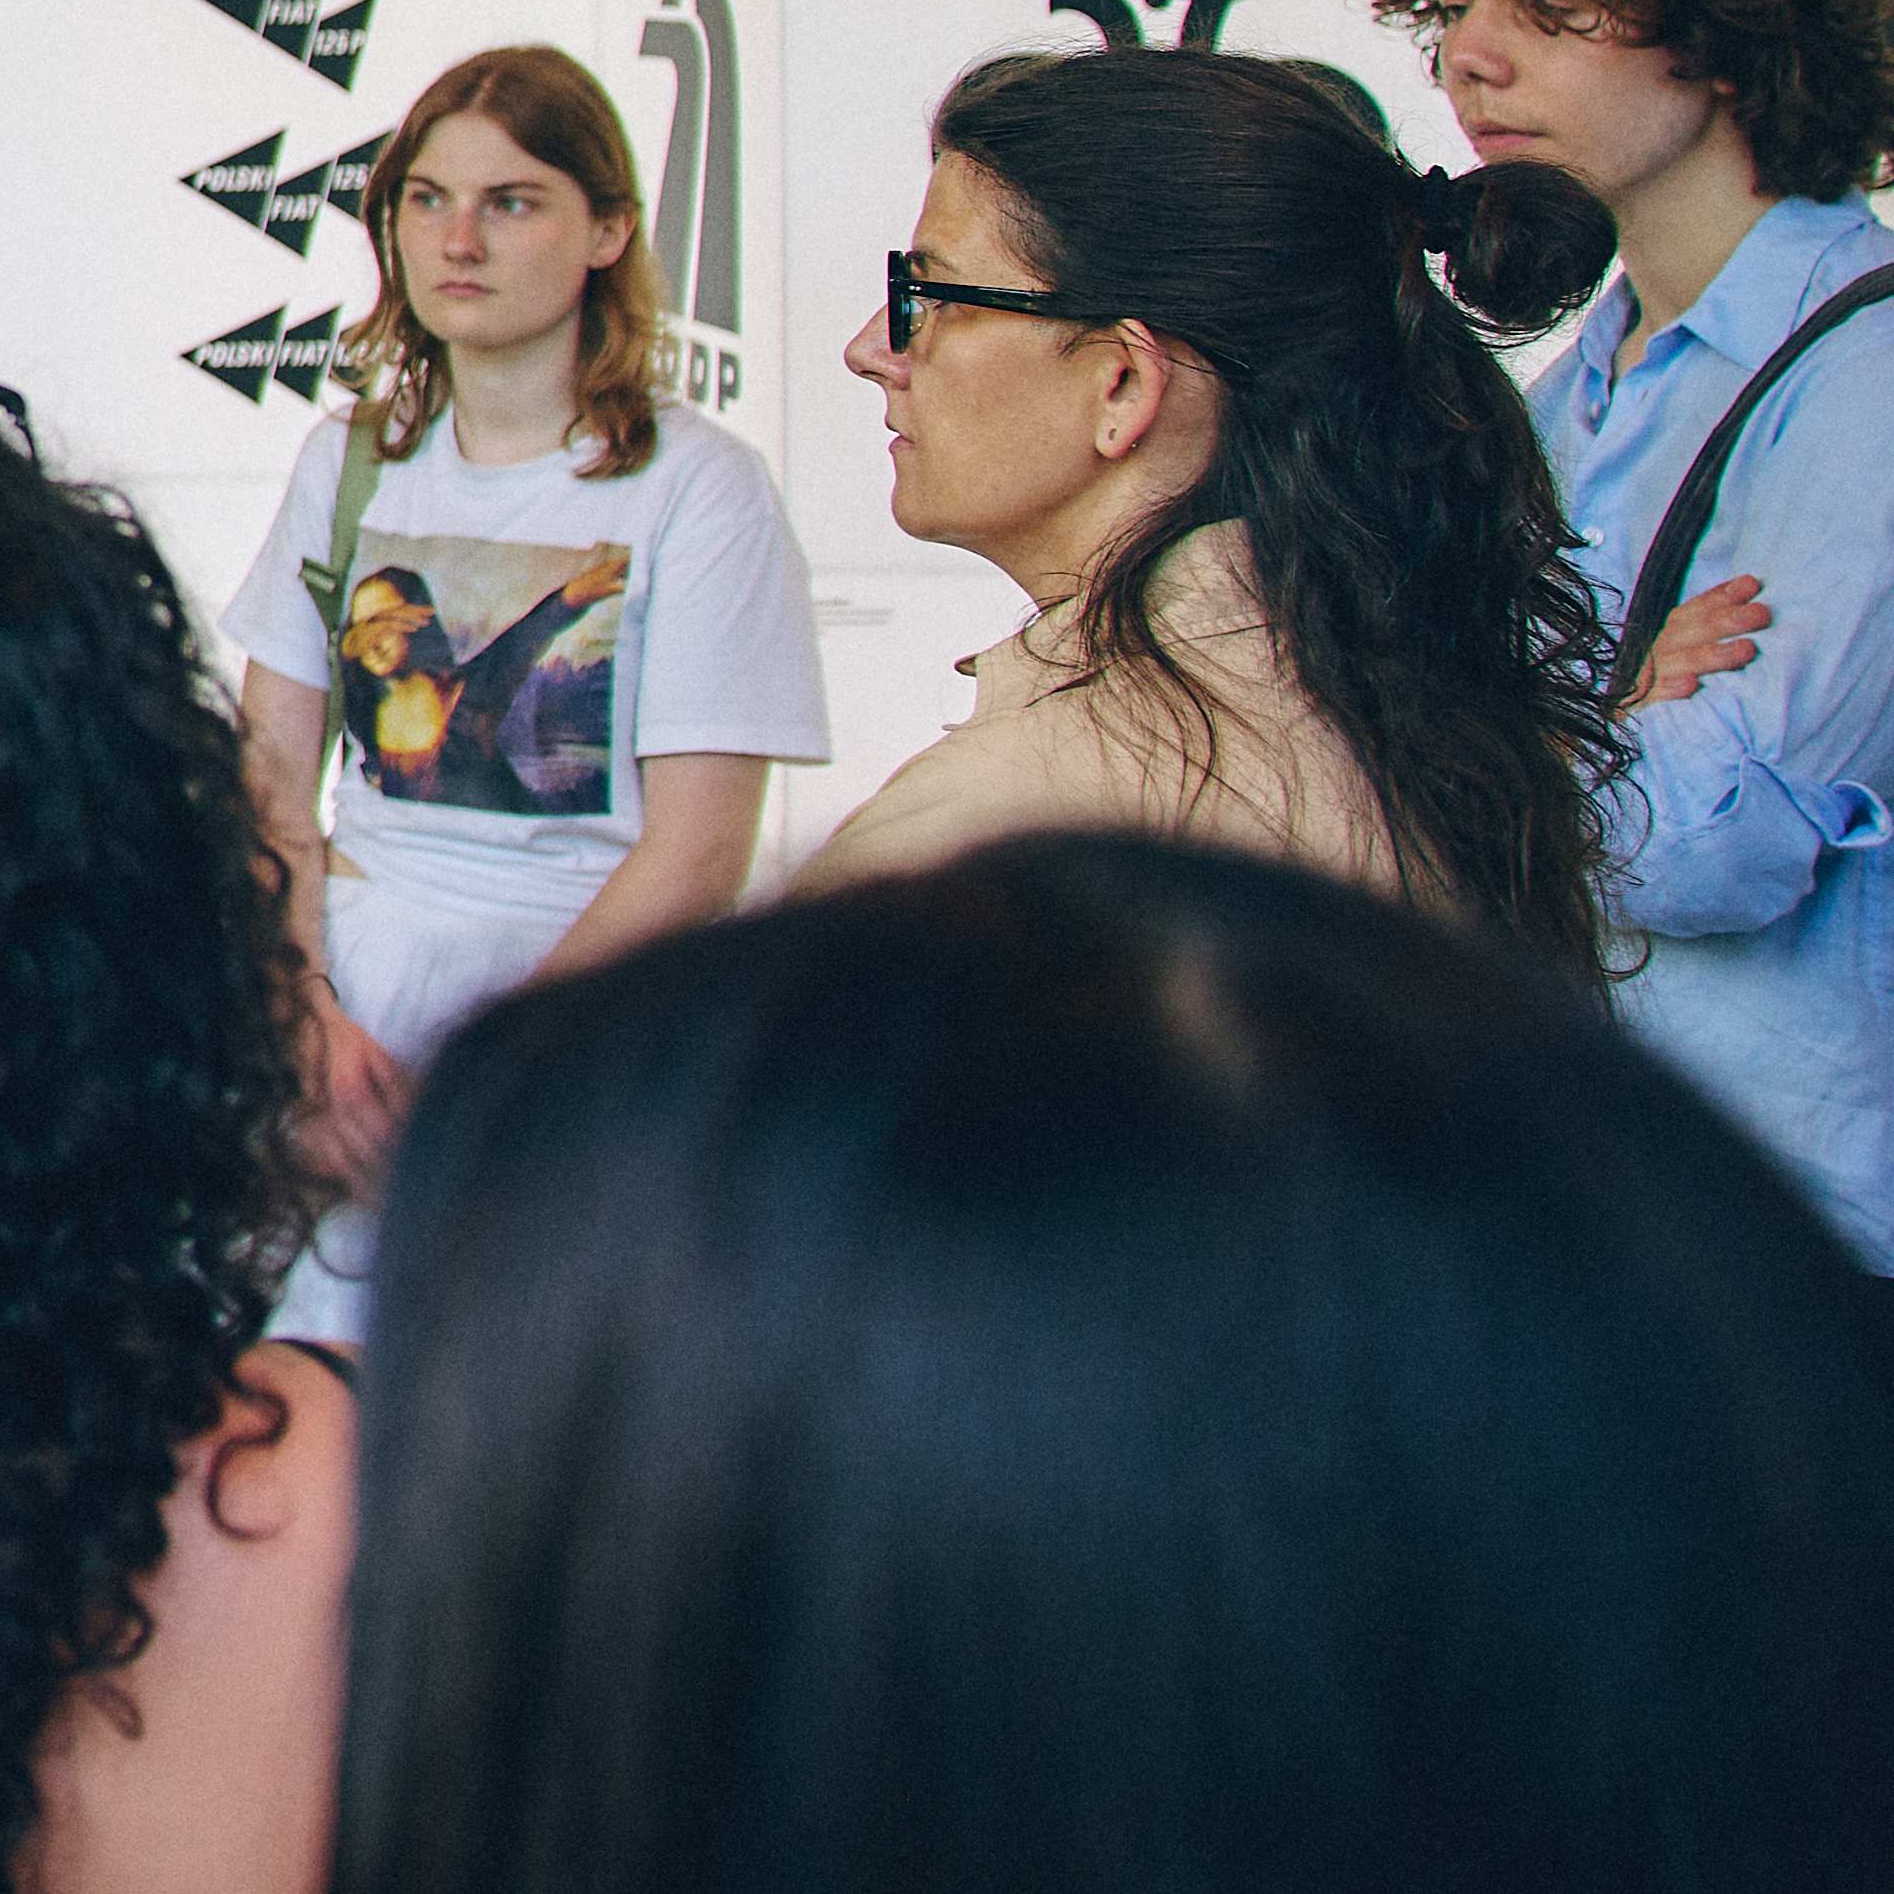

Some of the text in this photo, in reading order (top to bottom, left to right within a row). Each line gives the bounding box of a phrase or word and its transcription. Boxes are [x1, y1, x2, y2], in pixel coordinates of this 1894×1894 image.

[195, 164, 275, 193] POLSKI
[273, 193, 321, 222] FIAT
[195, 340, 276, 368] POLSKI
[278, 339, 328, 367] FIAT
